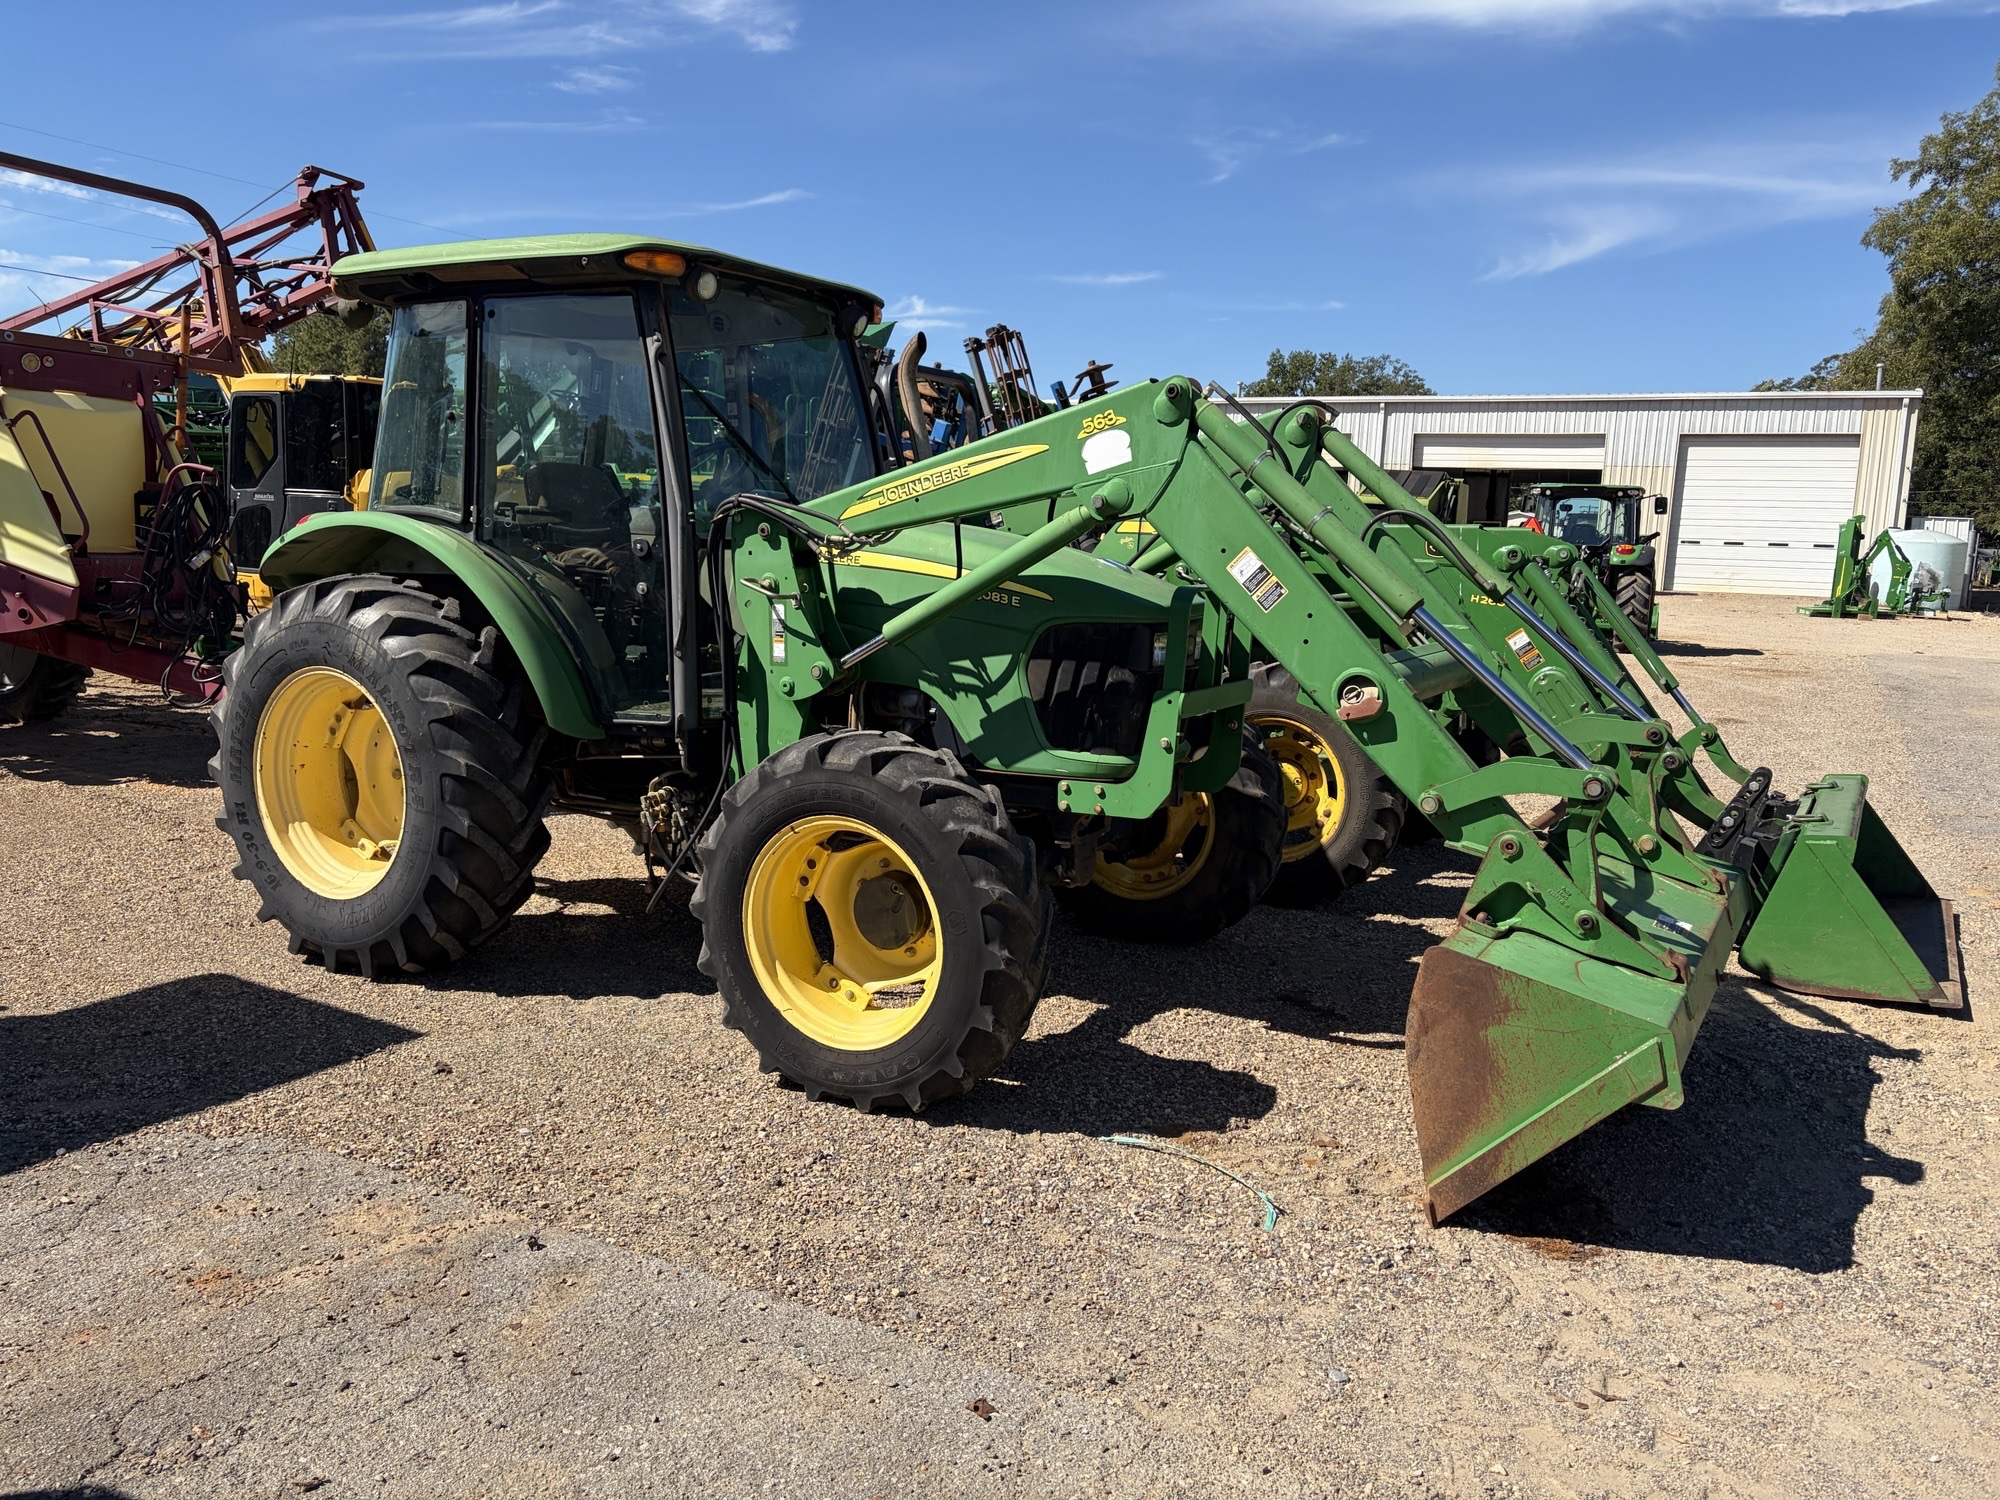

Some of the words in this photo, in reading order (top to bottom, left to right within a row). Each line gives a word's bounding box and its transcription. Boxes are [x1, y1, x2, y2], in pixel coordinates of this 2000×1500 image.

[1082, 409, 1117, 434] 563
[878, 479, 921, 505] JOHN
[920, 463, 970, 490] DEERE
[977, 591, 1009, 604] 083
[1011, 595, 1021, 607] E
[1470, 594, 1506, 607] H26
[1346, 741, 1370, 835] HI-TRACTION
[782, 1052, 922, 1083] GALAXY
